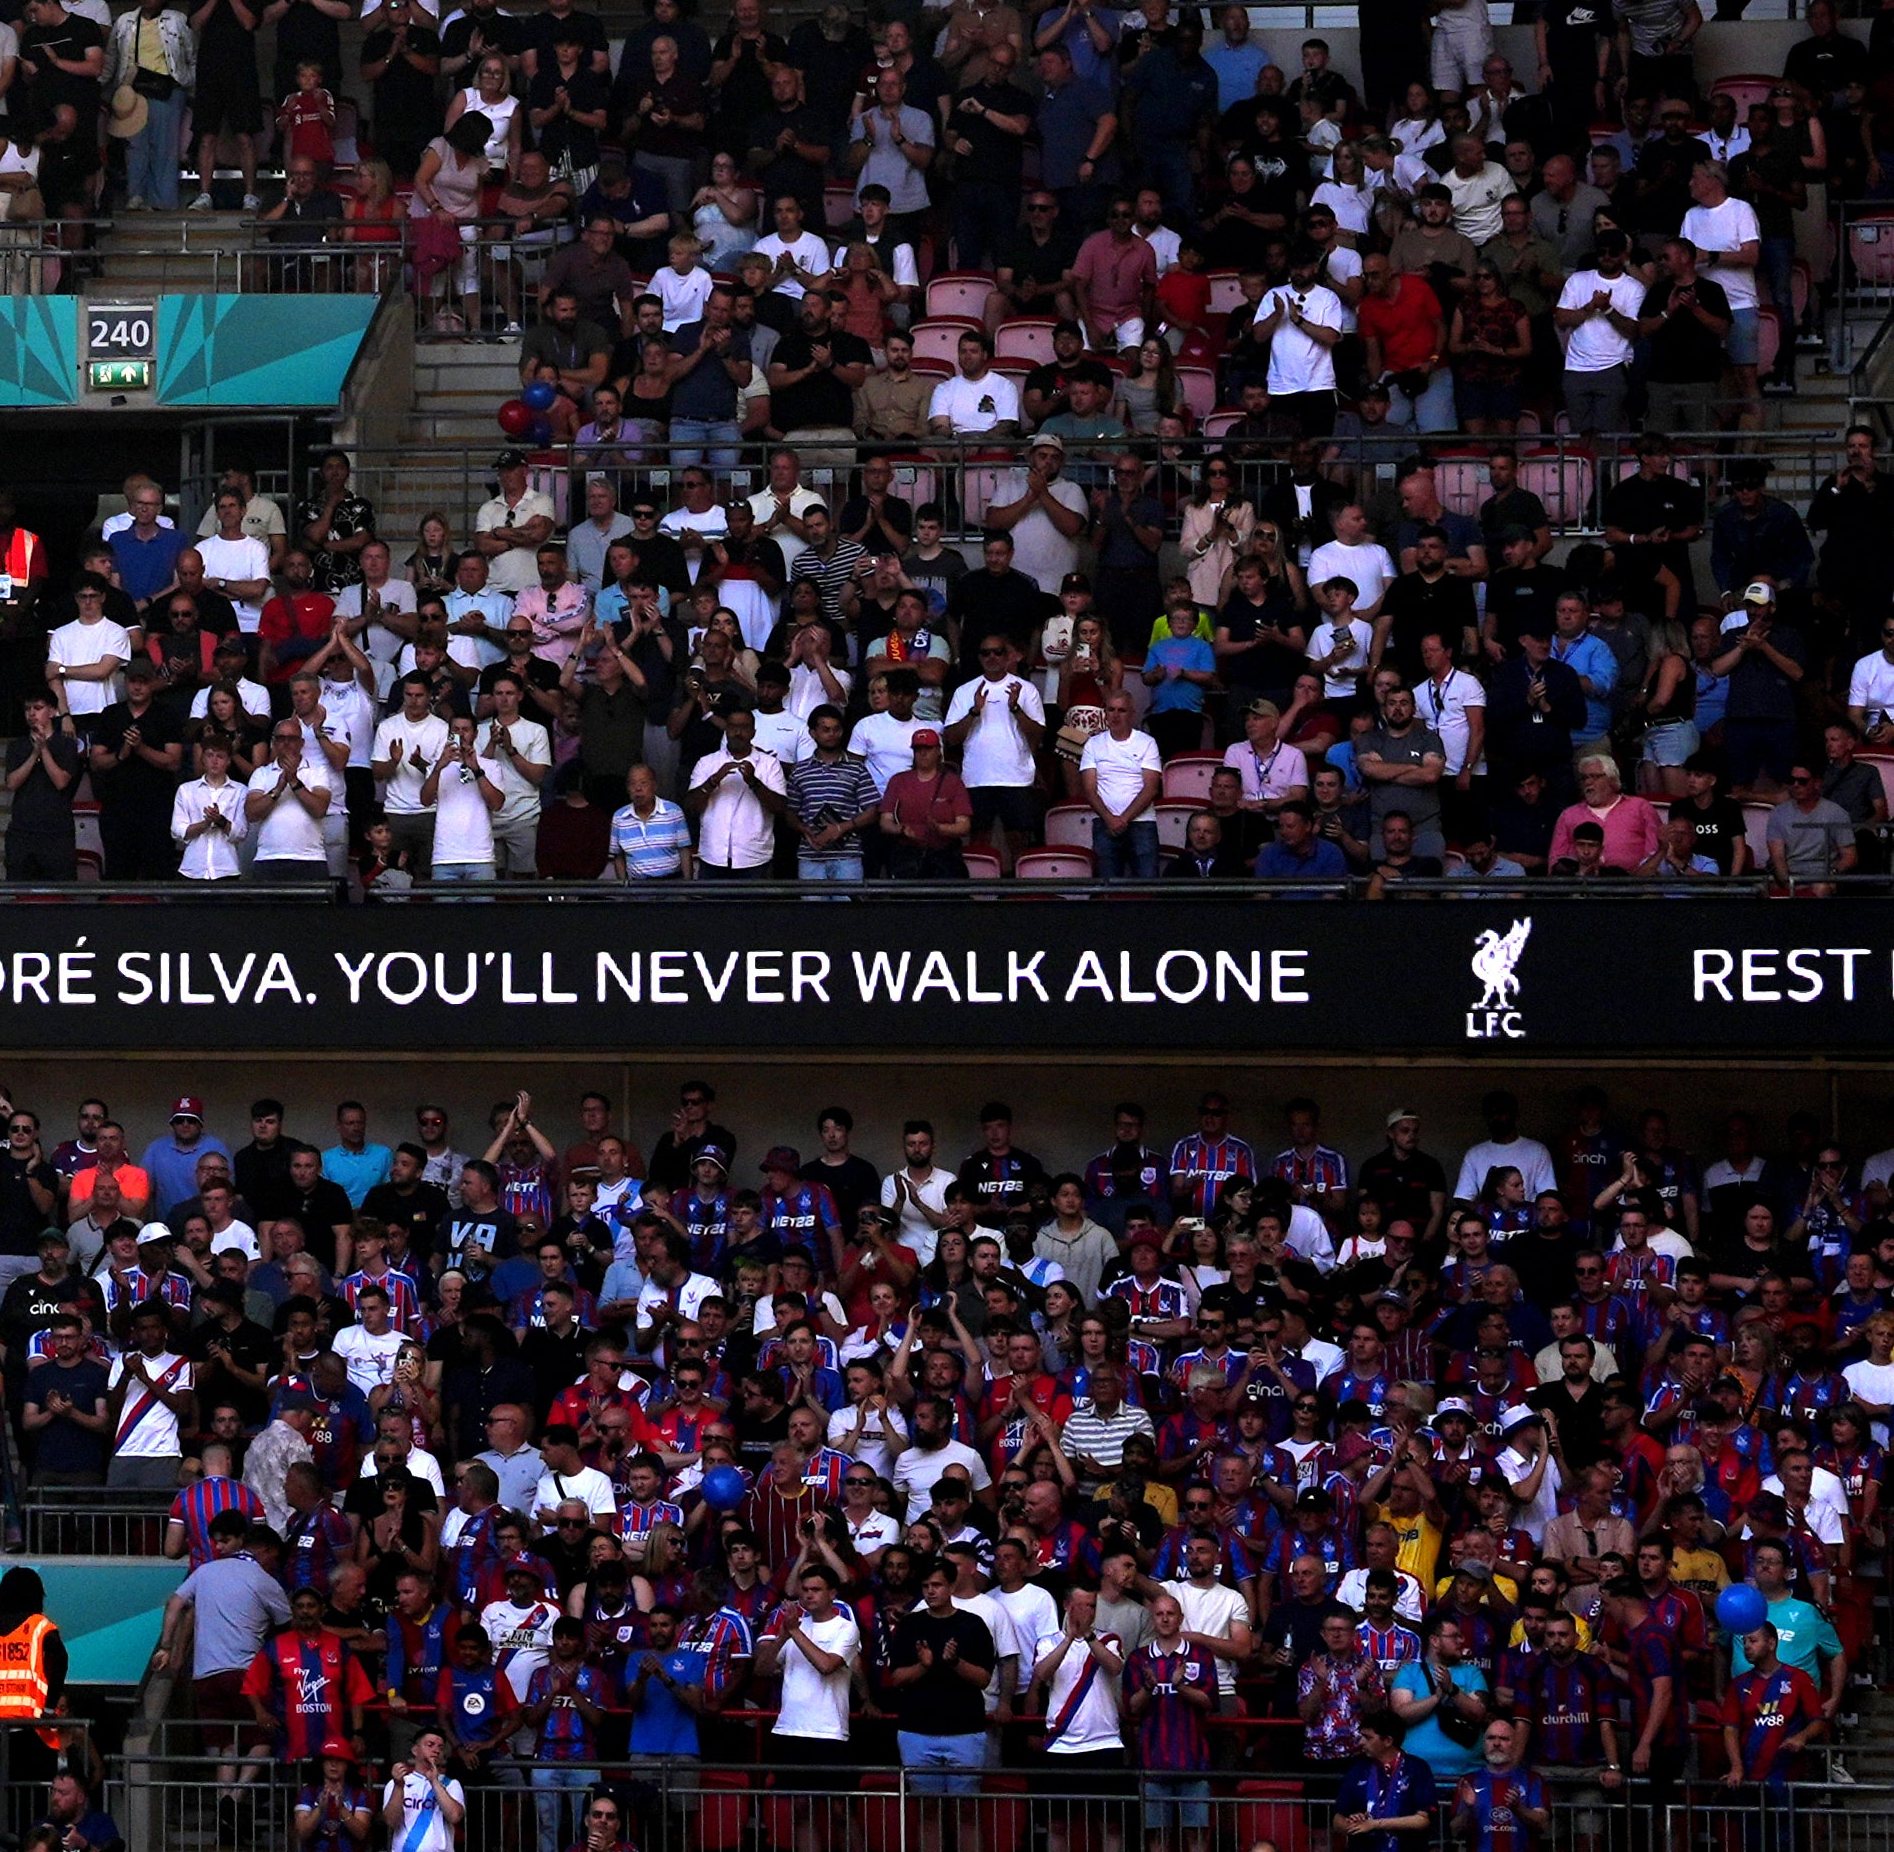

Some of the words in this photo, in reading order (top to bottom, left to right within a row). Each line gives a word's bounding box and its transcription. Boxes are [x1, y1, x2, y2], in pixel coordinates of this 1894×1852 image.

[88, 320, 150, 348] 240
[1695, 824, 1719, 835] OSS
[118, 951, 317, 1005] SILVA.
[335, 951, 578, 1005] YOU'LL
[597, 950, 831, 1003] NEVER
[852, 950, 1050, 1003] WALK
[1065, 949, 1310, 1004] ALONE
[1694, 948, 1872, 1003] REST
[977, 1179, 1024, 1193] NET88
[770, 1215, 816, 1229] NET88
[295, 1677, 332, 1702] Virgin
[295, 1702, 334, 1713] BOSTON
[1753, 1715, 1784, 1727] W88
